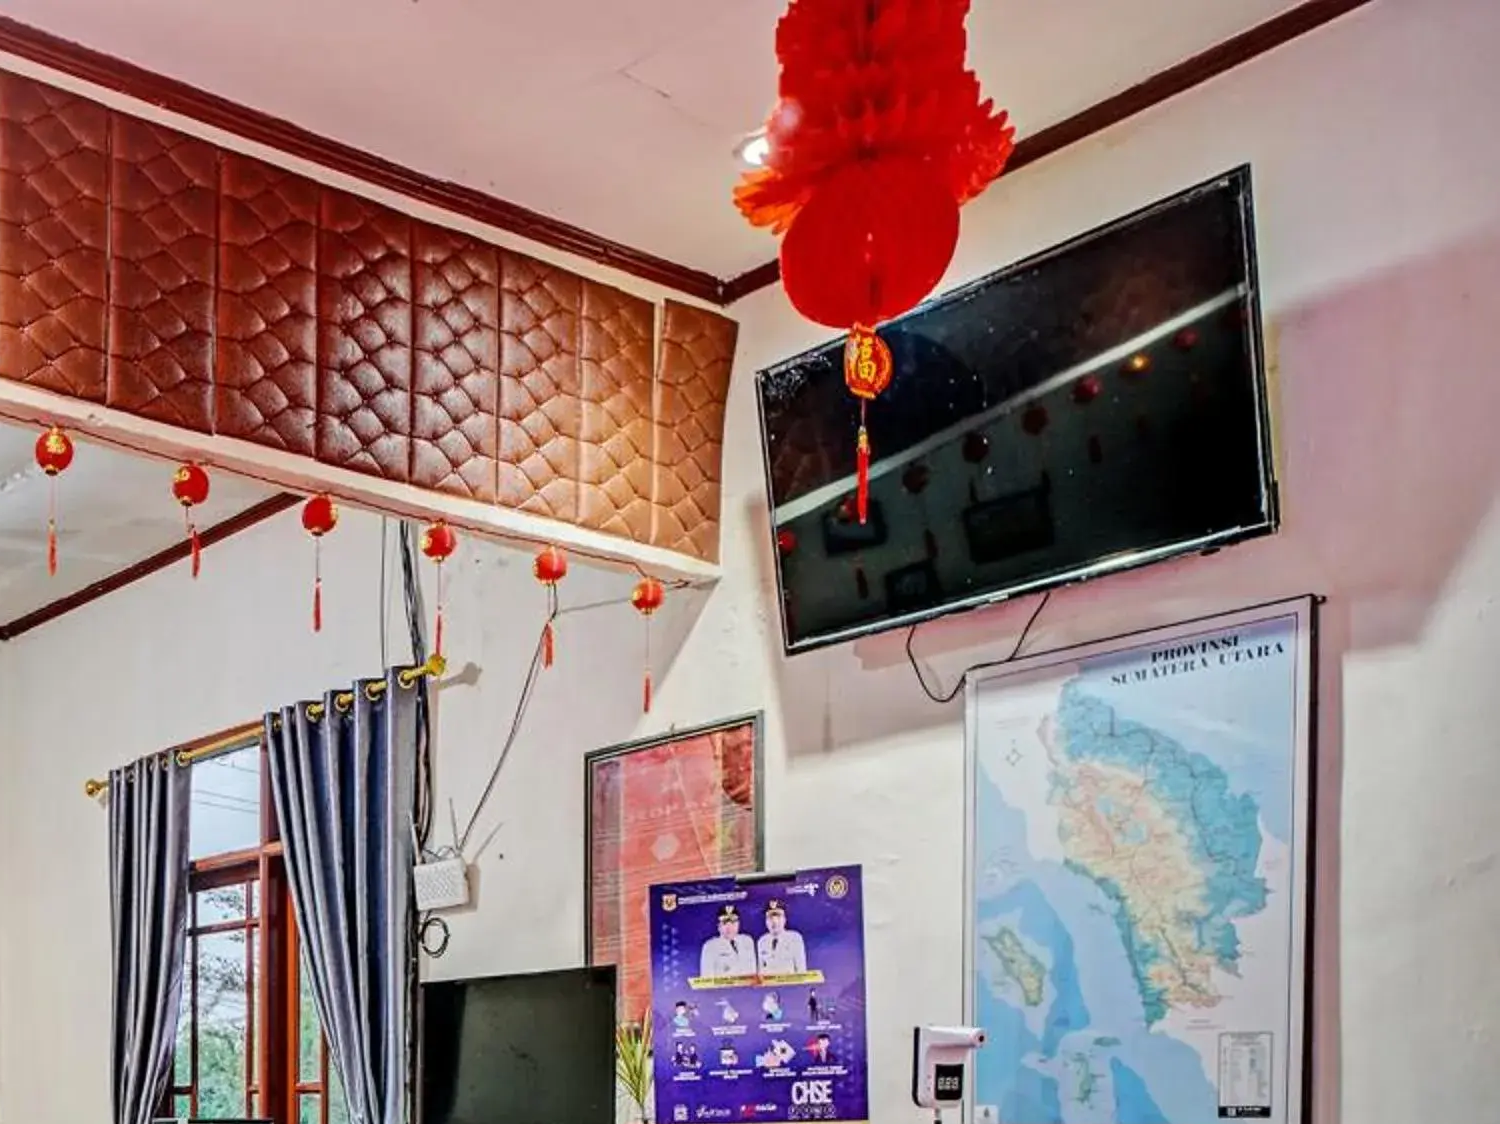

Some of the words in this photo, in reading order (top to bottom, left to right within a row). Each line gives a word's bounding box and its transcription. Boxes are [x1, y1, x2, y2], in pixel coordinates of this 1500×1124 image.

[1111, 657, 1209, 685] SUMATERA
[1219, 641, 1285, 665] UTARA
[1151, 635, 1240, 663] PROVINSI
[791, 1080, 833, 1105] CHSE
